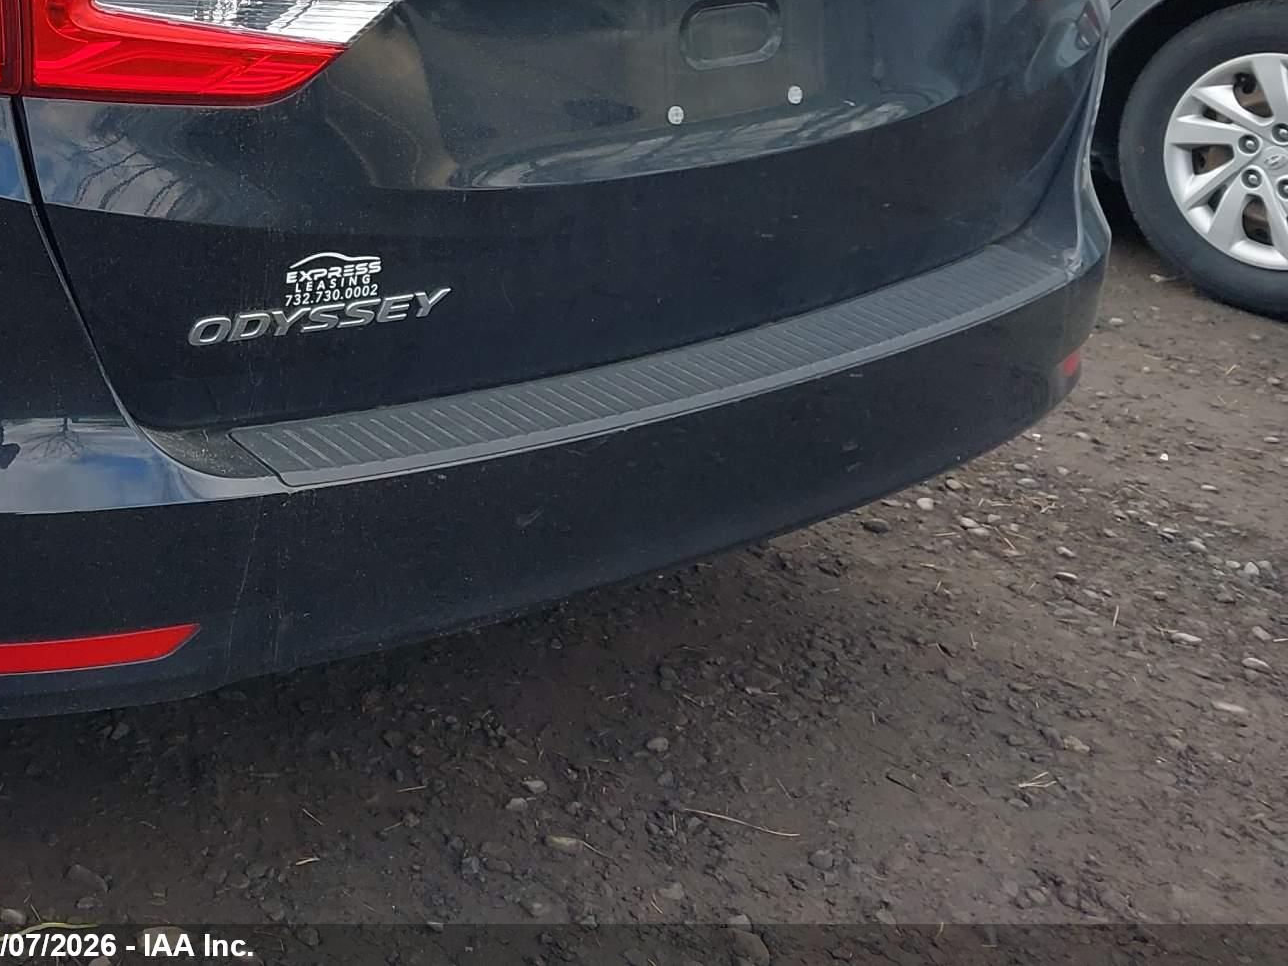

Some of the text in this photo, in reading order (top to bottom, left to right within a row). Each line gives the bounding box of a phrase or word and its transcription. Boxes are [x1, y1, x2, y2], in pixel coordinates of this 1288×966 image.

[285, 260, 382, 284] EXPRESS
[294, 274, 372, 293] LEASING
[284, 284, 379, 307] 732.730.0002
[188, 287, 452, 346] ODYSSEY
